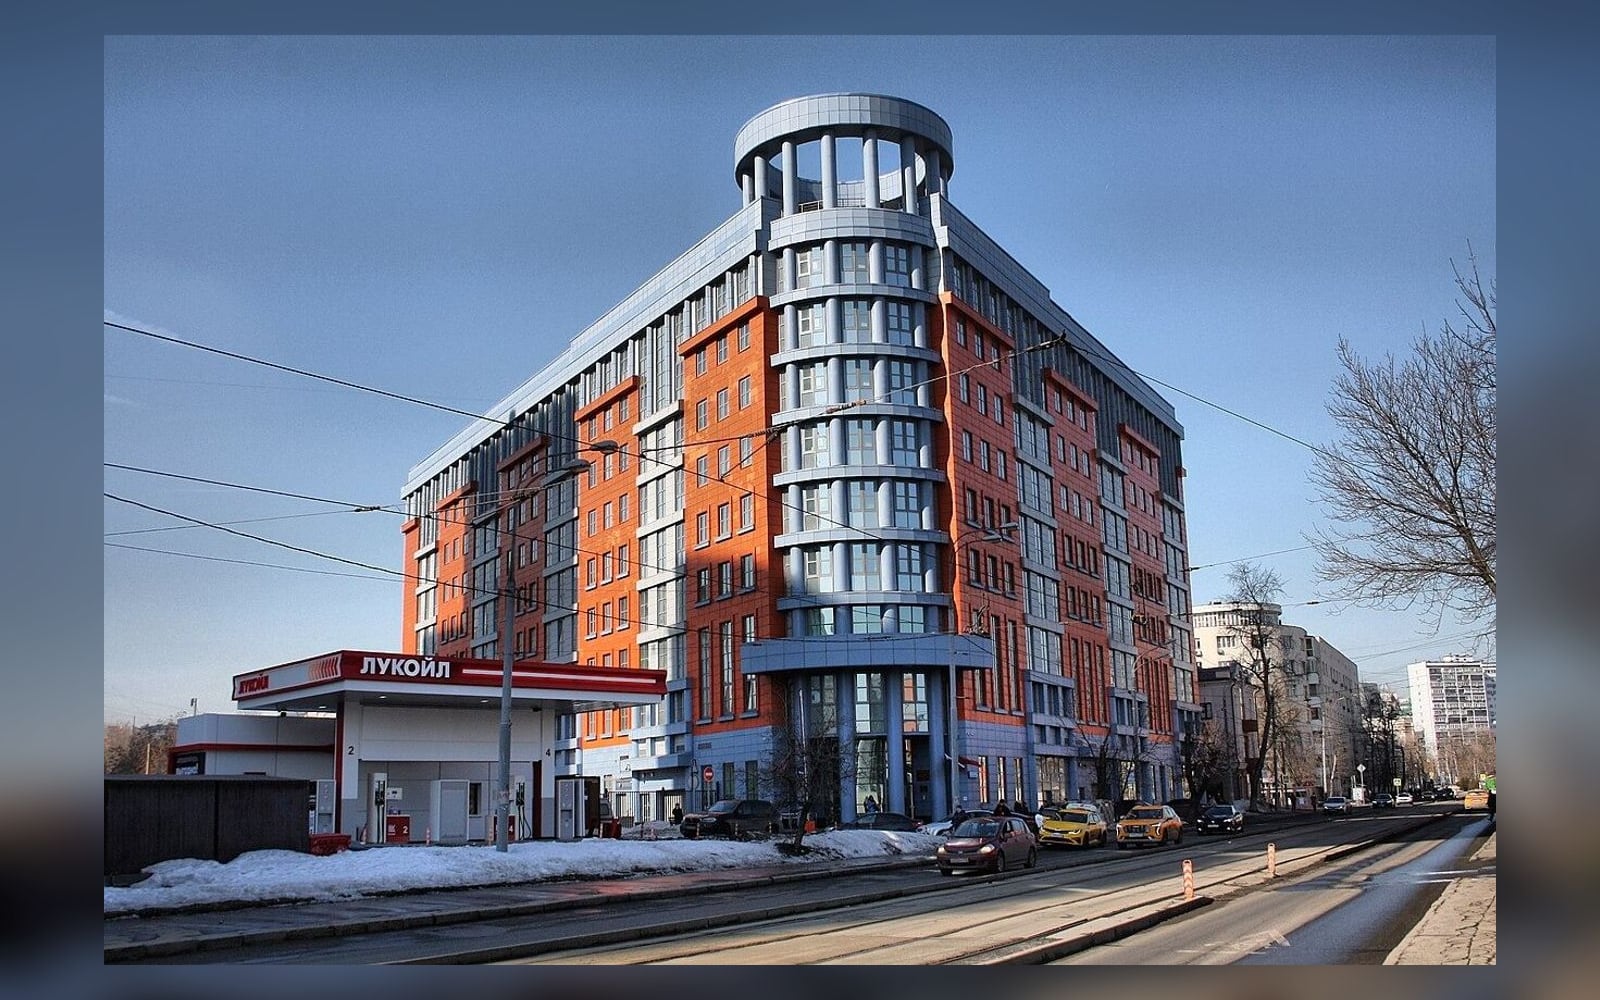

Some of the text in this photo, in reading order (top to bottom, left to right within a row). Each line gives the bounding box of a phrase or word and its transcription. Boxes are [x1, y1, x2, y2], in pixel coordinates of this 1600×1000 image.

[360, 656, 450, 678] ЛУКОЙЛ
[348, 745, 355, 755] 2
[545, 748, 551, 757] 4
[402, 825, 409, 834] 2
